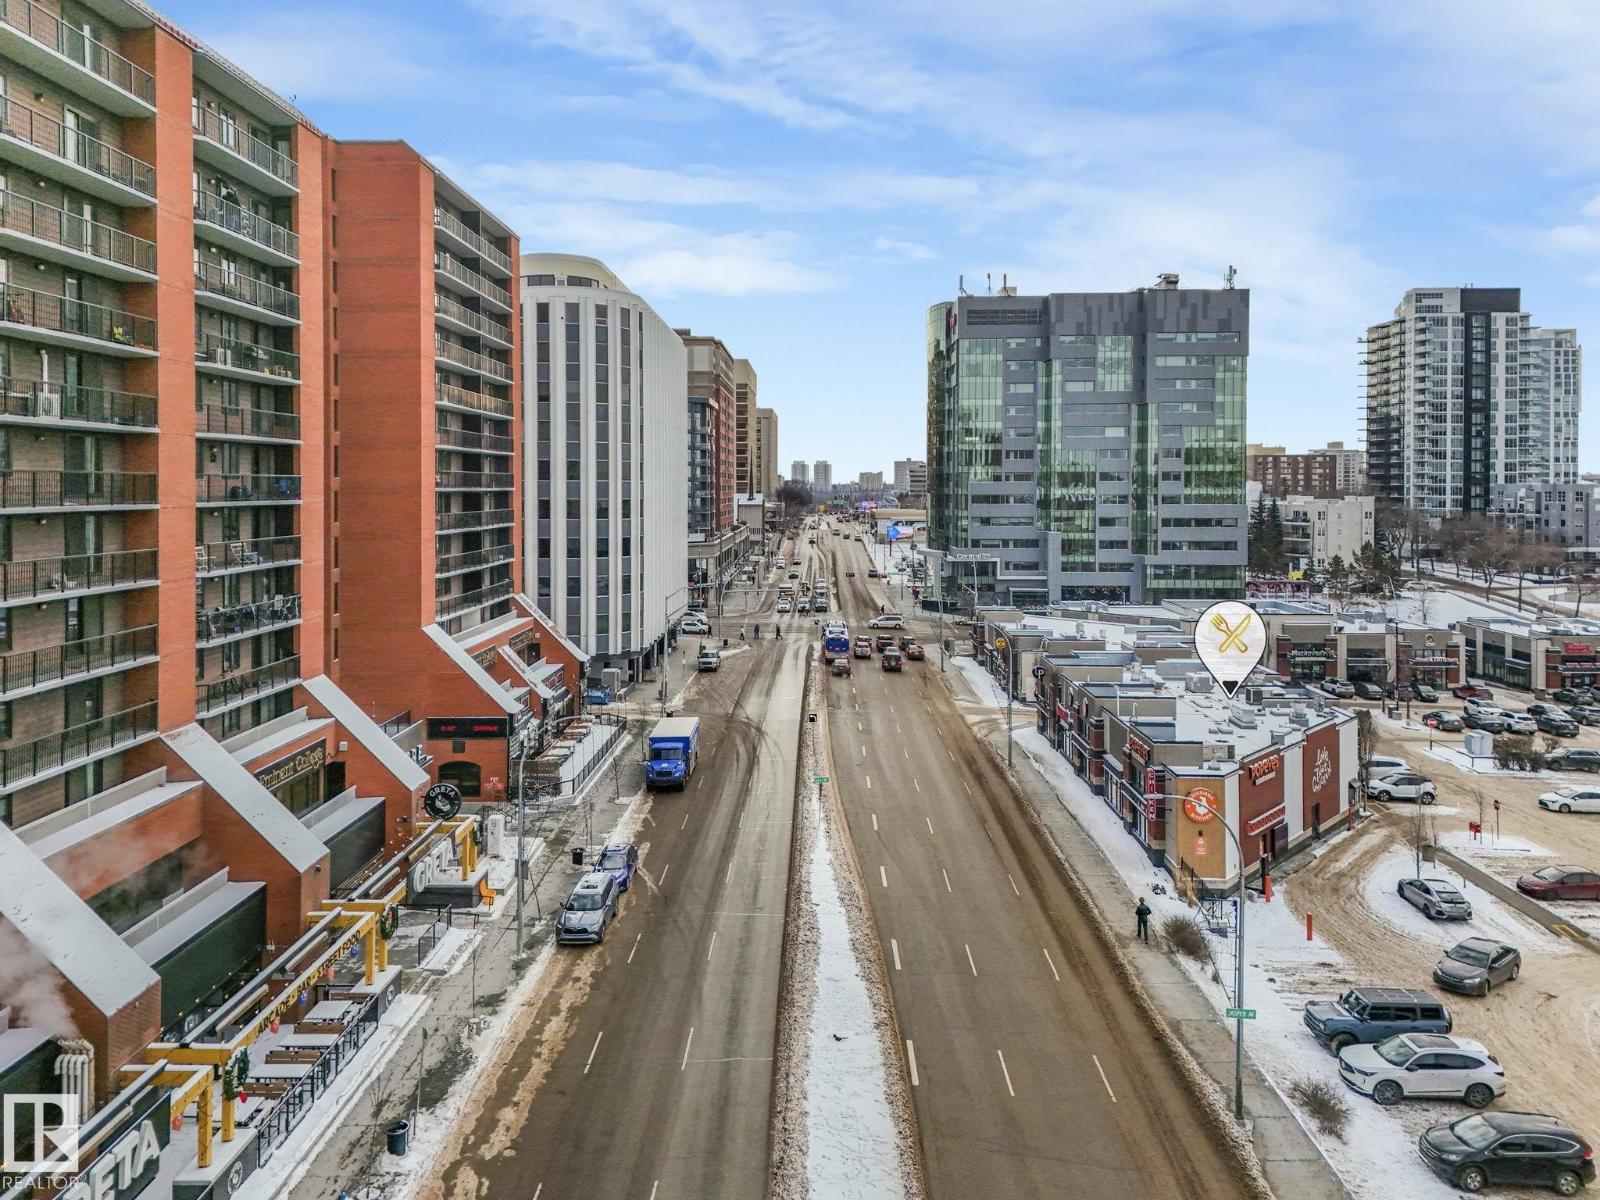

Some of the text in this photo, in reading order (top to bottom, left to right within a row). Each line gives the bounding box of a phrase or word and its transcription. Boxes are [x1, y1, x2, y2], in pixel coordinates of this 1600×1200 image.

[956, 552, 982, 560] Central
[429, 785, 456, 798] GRETA
[1147, 771, 1156, 820] CHIKEN
